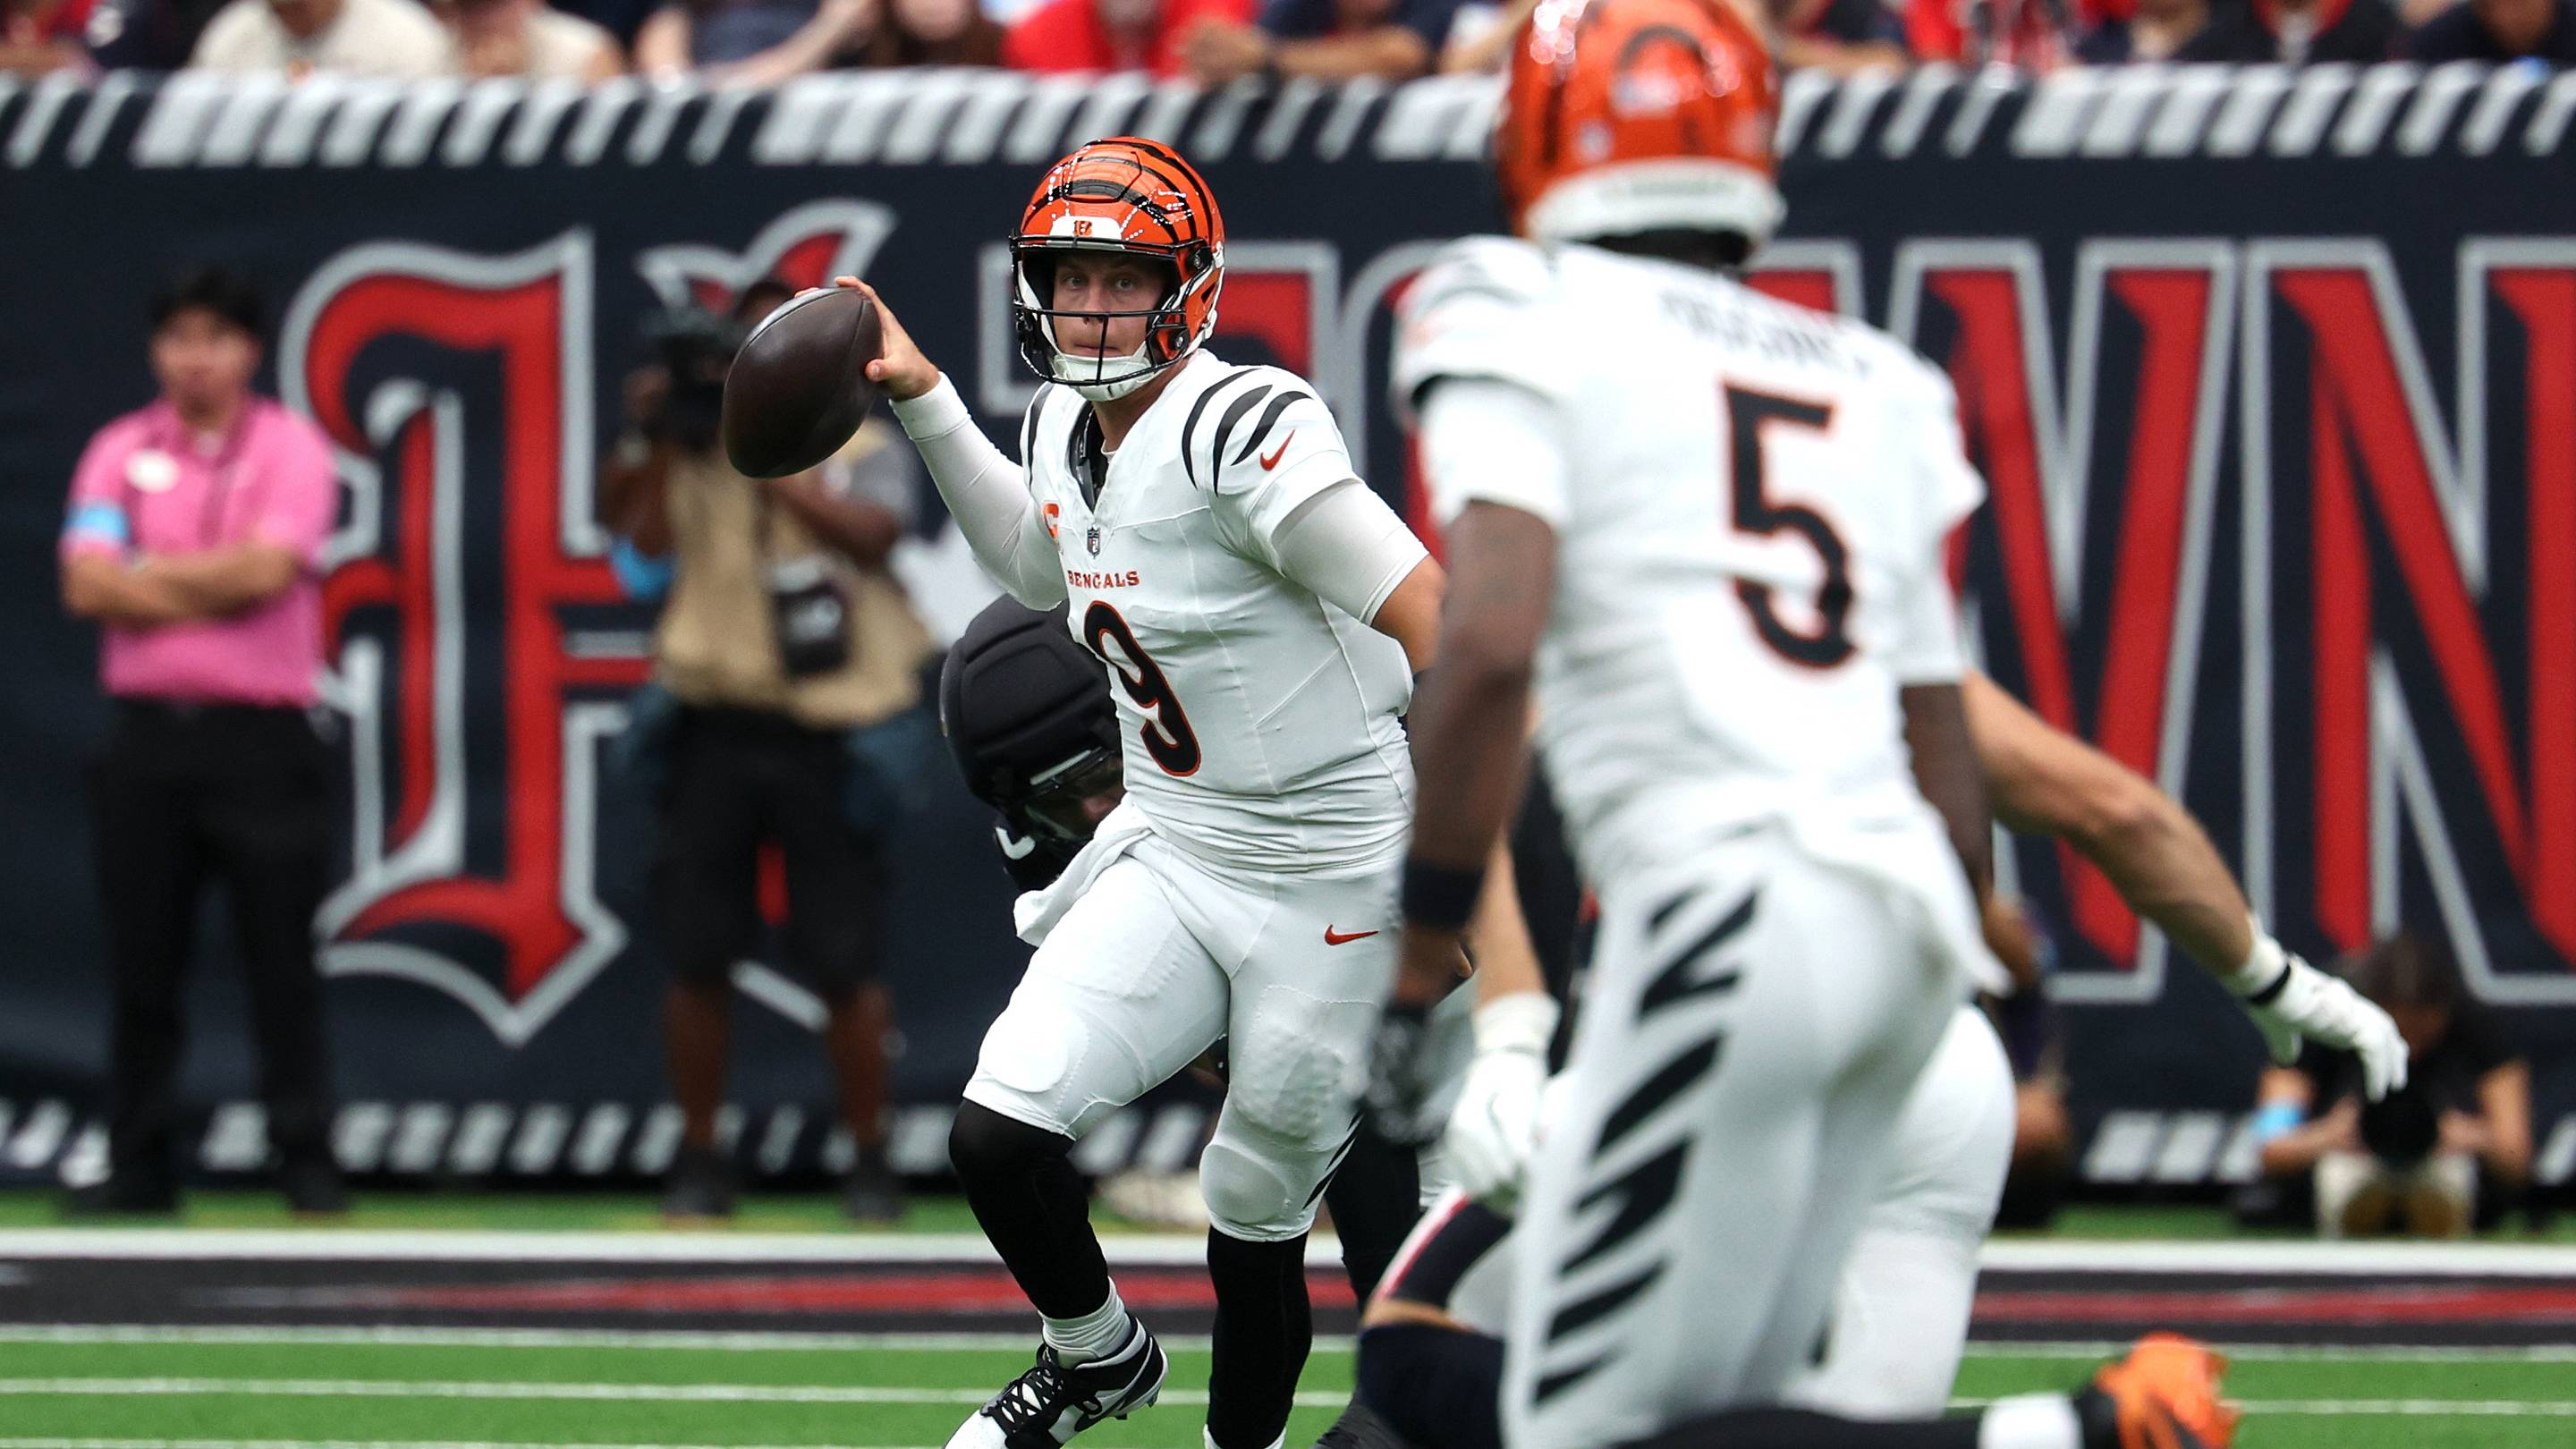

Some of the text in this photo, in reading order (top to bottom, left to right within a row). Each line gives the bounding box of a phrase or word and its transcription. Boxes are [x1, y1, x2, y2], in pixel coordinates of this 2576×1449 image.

[1067, 570, 1140, 589] BENGALS
[1717, 379, 1859, 669] 5
[1084, 600, 1201, 777] 9
